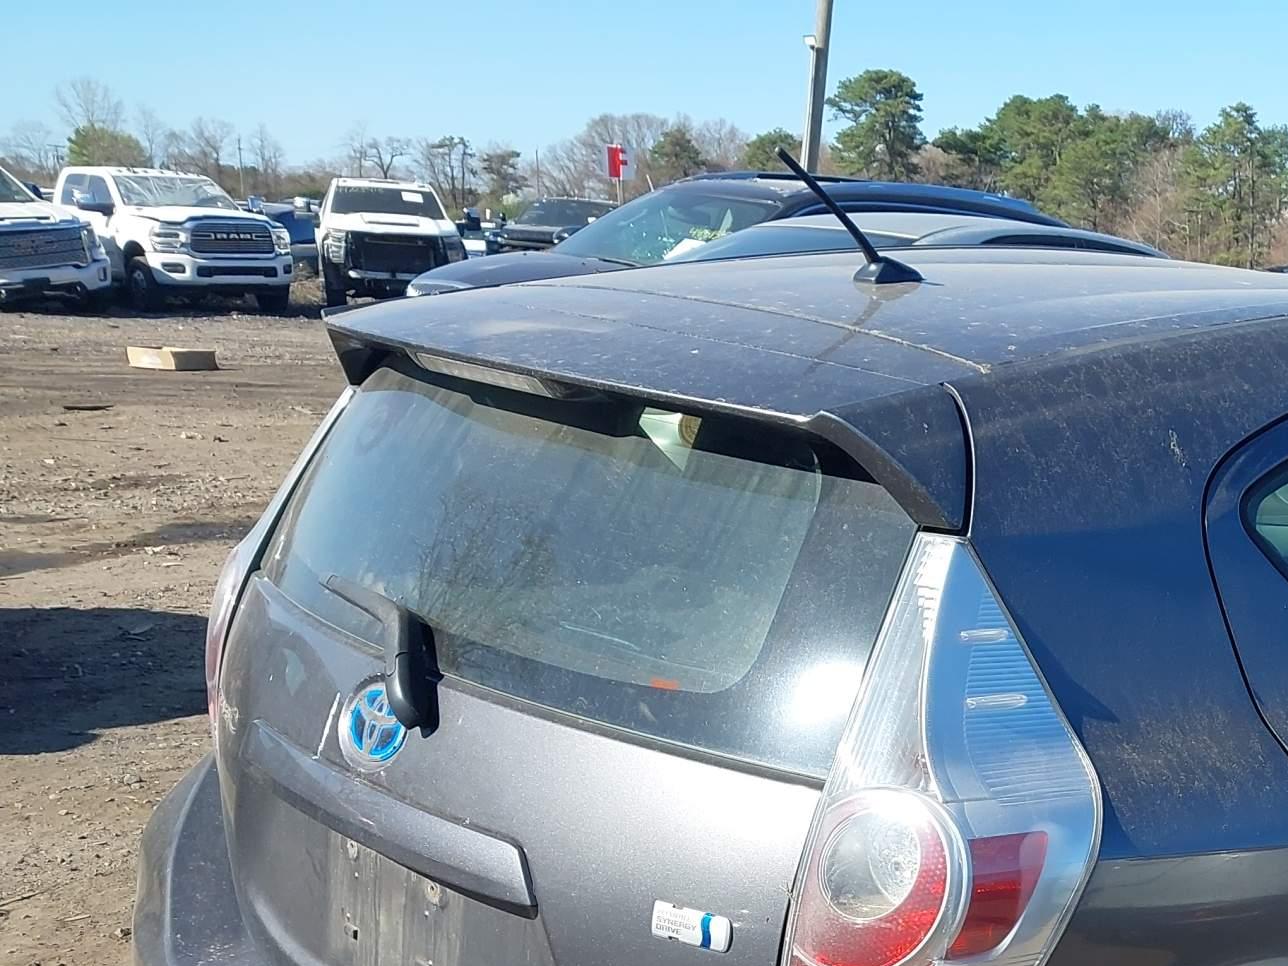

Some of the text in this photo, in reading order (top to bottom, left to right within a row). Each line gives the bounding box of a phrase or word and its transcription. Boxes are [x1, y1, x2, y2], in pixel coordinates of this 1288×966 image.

[215, 233, 251, 241] RAM
[656, 915, 697, 931] SYNERGY
[656, 922, 681, 935] DRIVE
